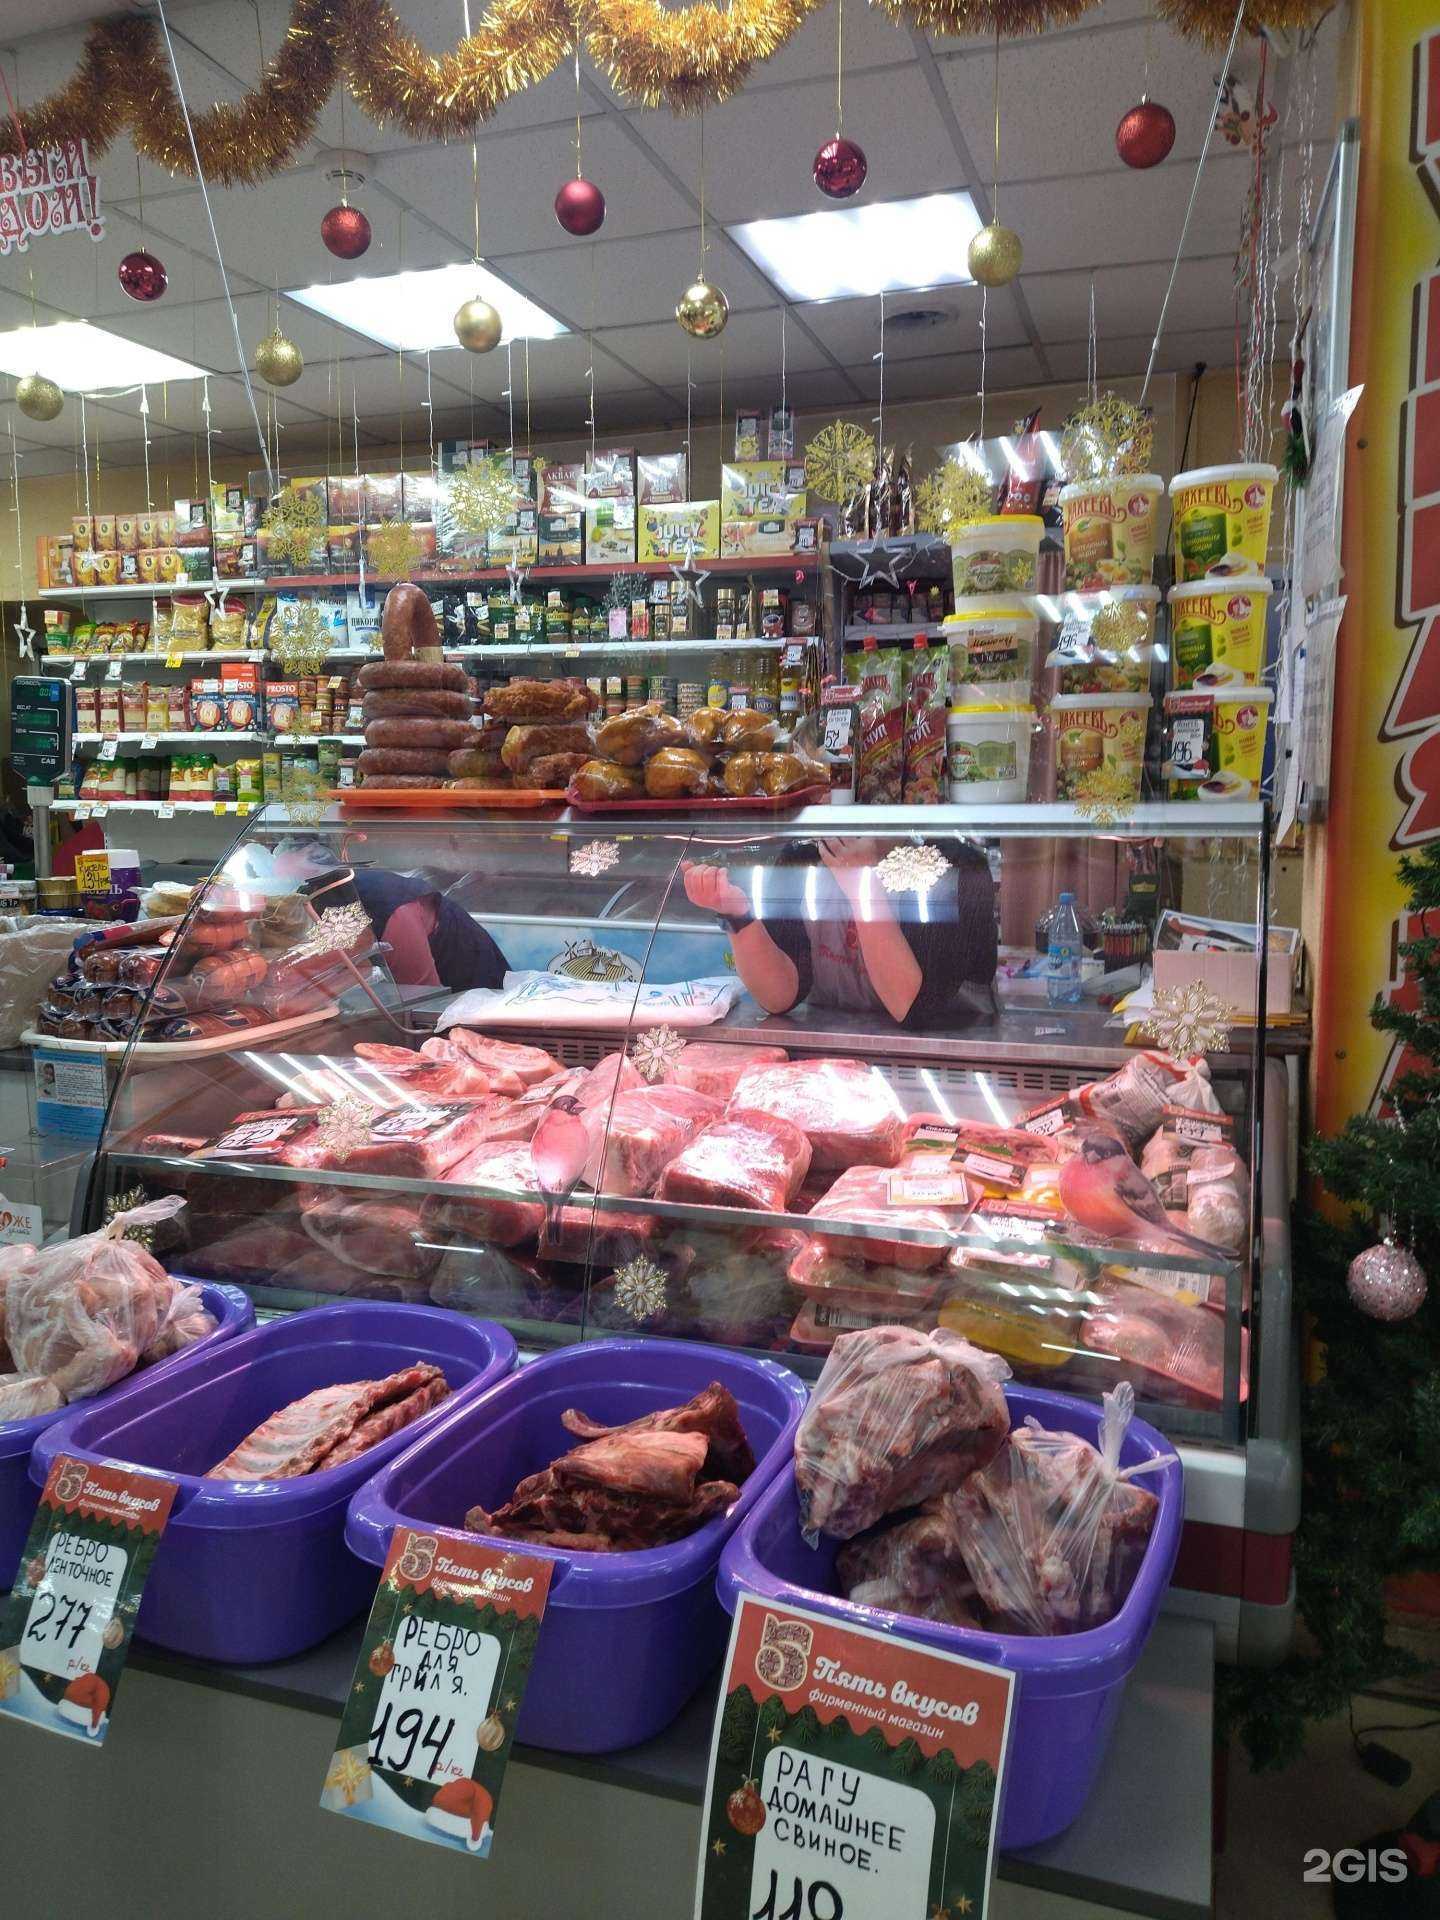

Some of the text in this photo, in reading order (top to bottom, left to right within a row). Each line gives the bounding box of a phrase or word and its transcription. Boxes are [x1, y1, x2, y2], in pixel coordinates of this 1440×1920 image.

[266, 685, 297, 694] PROSTO
[55, 1531, 109, 1563] РЕБРО
[434, 1556, 480, 1580] Пять
[46, 1556, 114, 1588] ЛЕНТОЧНОЕ
[27, 1592, 93, 1649] 277
[403, 1615, 481, 1656] РЕБРО
[418, 1650, 459, 1674] ДЛЯ
[808, 1687, 946, 1740] фирменный магазин
[812, 1655, 887, 1699] Пять
[890, 1679, 981, 1727] вкусов
[367, 1701, 456, 1780] 194
[777, 1751, 861, 1807] РАГУ
[766, 1785, 907, 1852] ДОМАШНЕЕ
